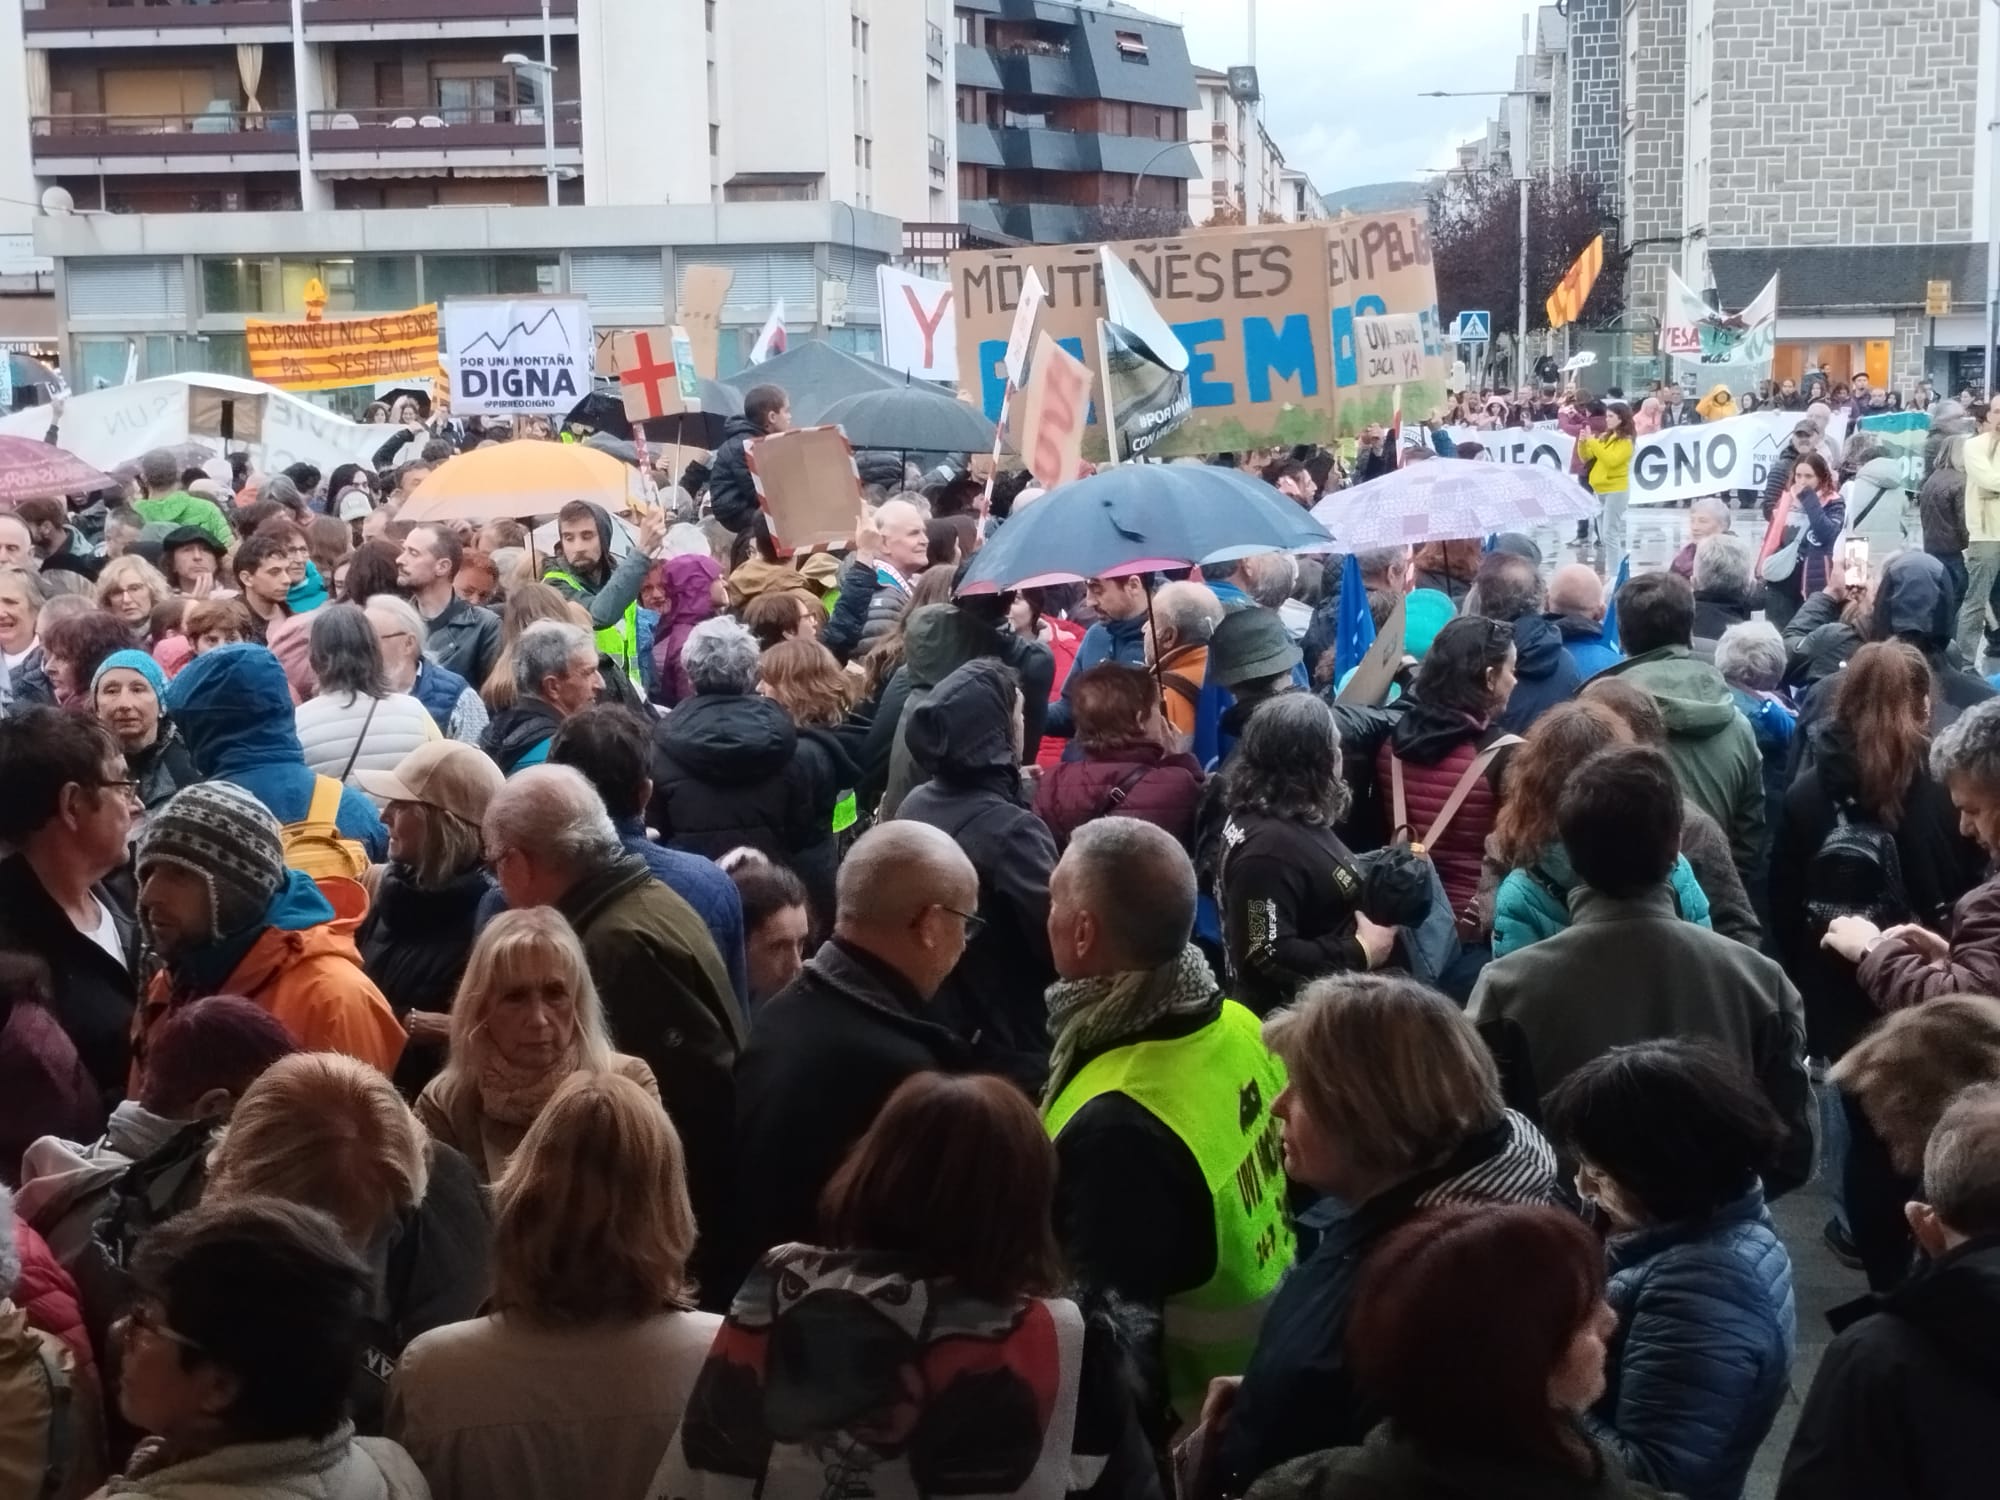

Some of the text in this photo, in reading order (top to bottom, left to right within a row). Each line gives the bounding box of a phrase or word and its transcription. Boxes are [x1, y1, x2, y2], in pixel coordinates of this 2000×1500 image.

[339, 320, 363, 345] NO
[369, 318, 391, 344] SE
[460, 357, 484, 367] POR
[514, 354, 574, 366] MONTAÑA
[461, 368, 578, 398] DIGNA
[1634, 434, 1737, 491] GNO
